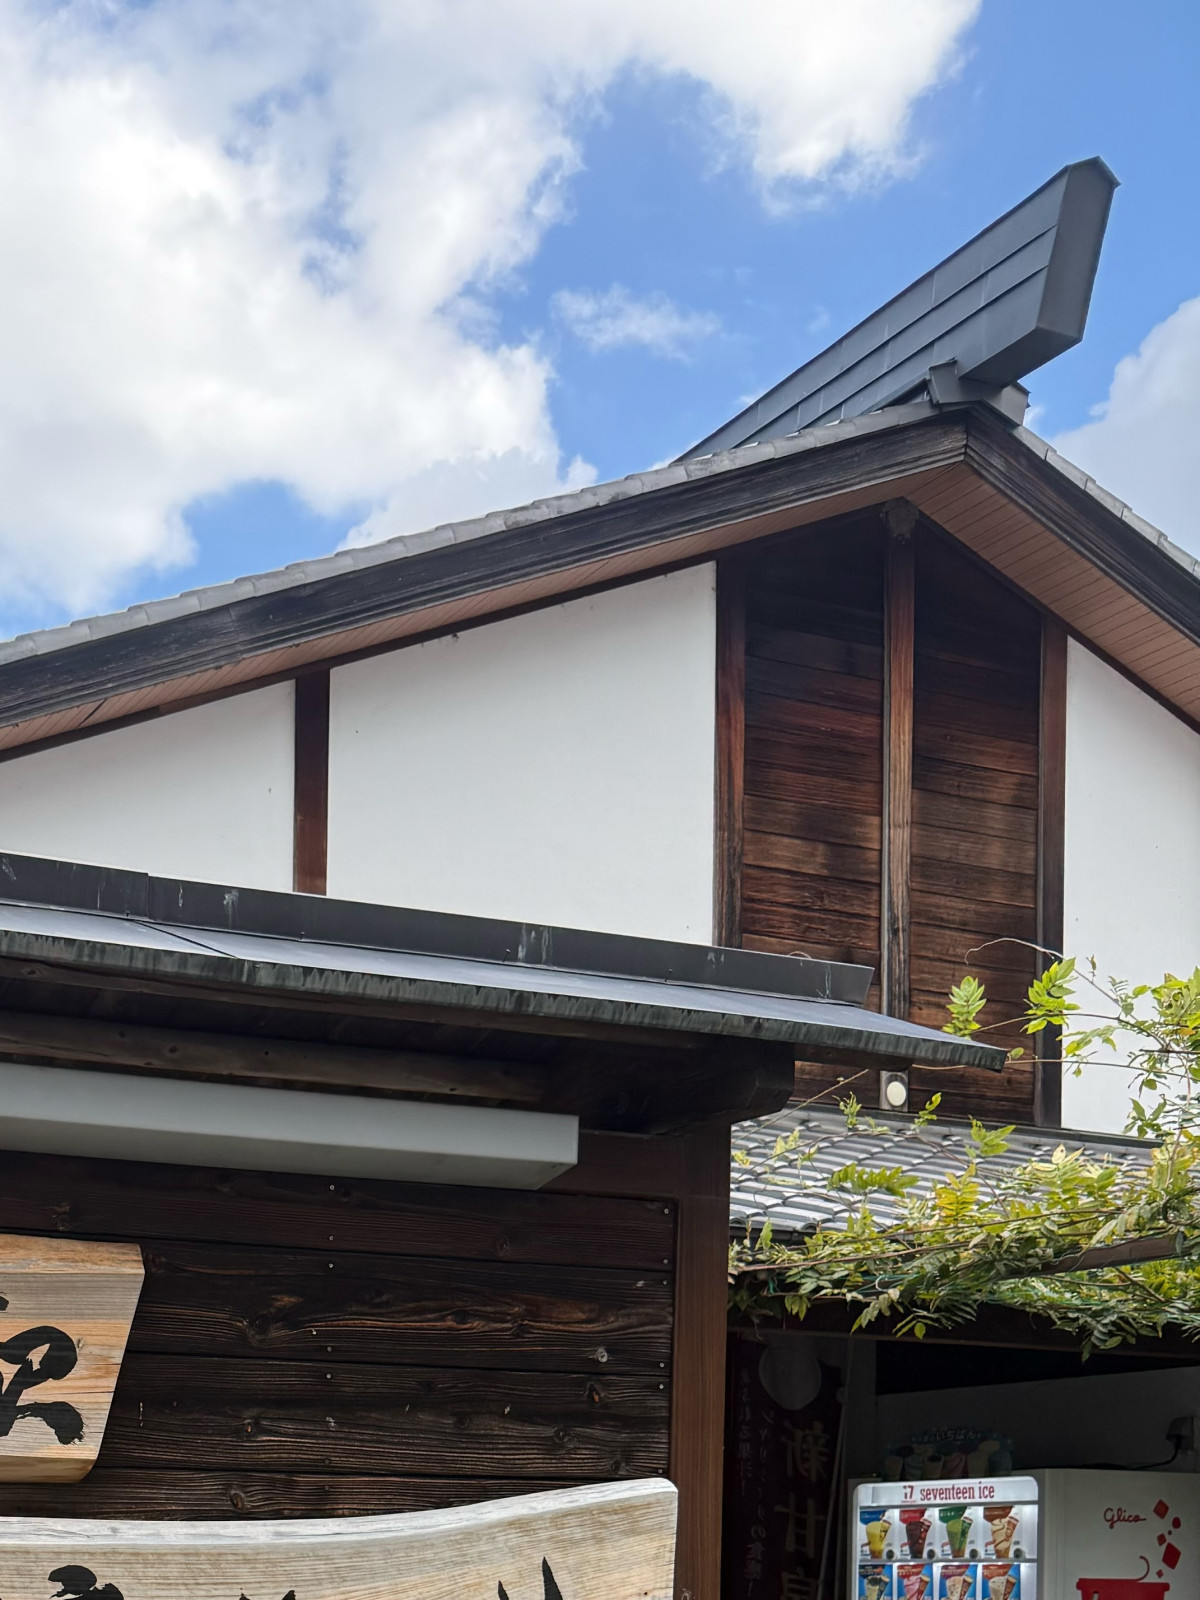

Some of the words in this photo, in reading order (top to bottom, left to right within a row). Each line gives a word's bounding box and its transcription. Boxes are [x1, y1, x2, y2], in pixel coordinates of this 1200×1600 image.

[920, 1484, 976, 1502] seventeen
[978, 1481, 995, 1500] ice
[1103, 1507, 1147, 1530] Glico
